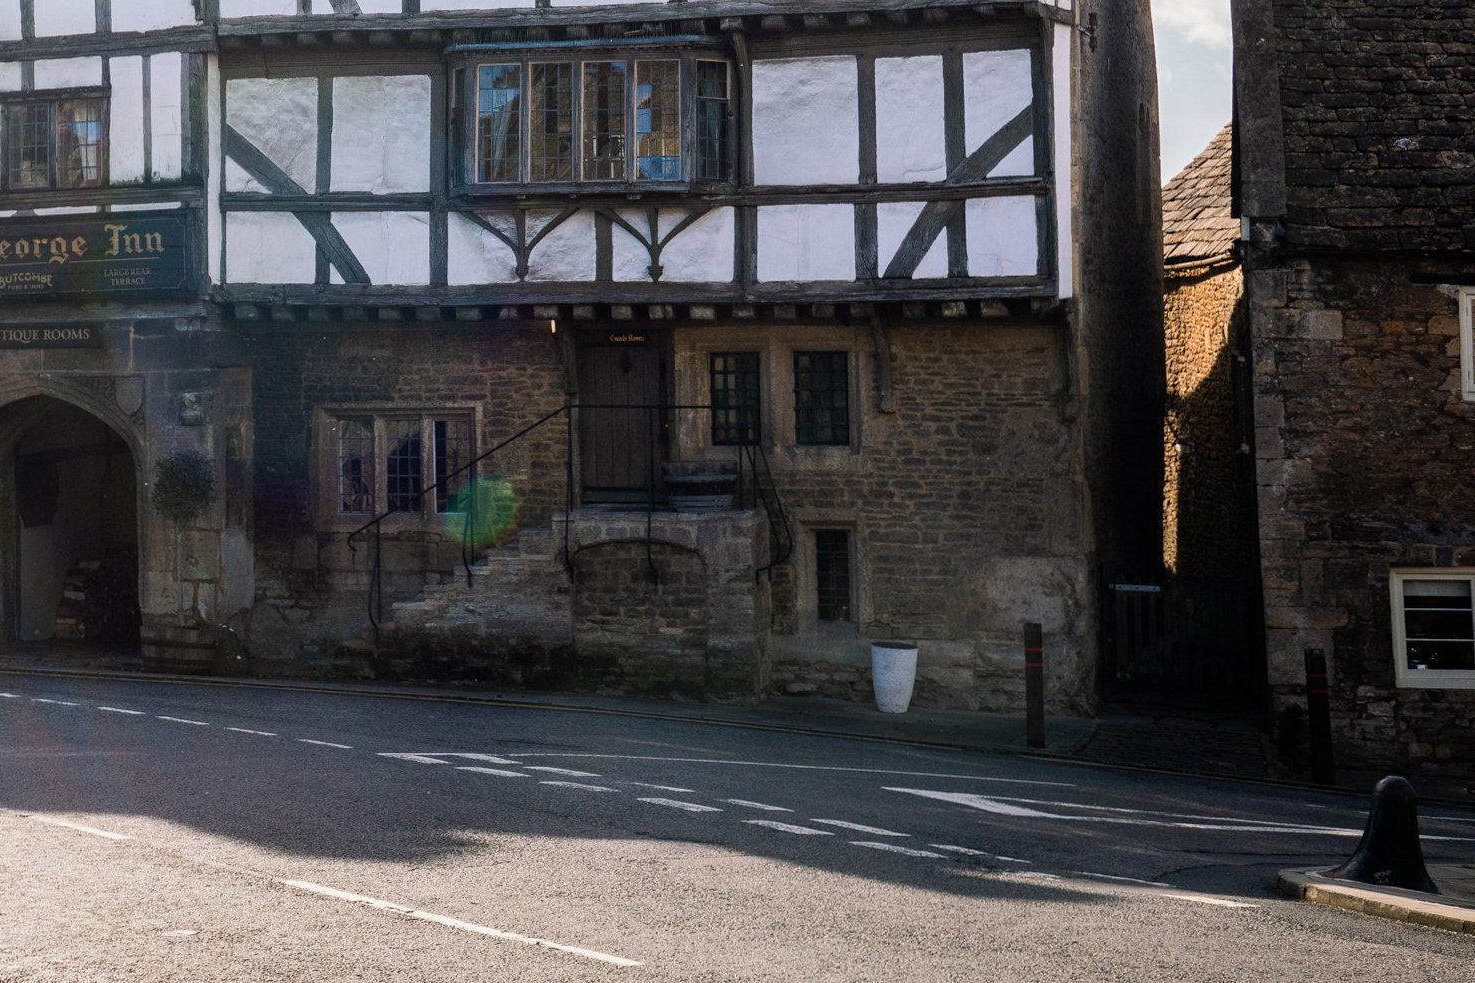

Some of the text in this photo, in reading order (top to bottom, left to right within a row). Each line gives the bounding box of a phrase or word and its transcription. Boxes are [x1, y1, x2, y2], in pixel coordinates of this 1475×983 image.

[104, 223, 165, 257] Inn
[103, 267, 152, 278] LARGE REAR
[111, 277, 146, 287] TERRACE
[44, 329, 91, 340] ROOMS
